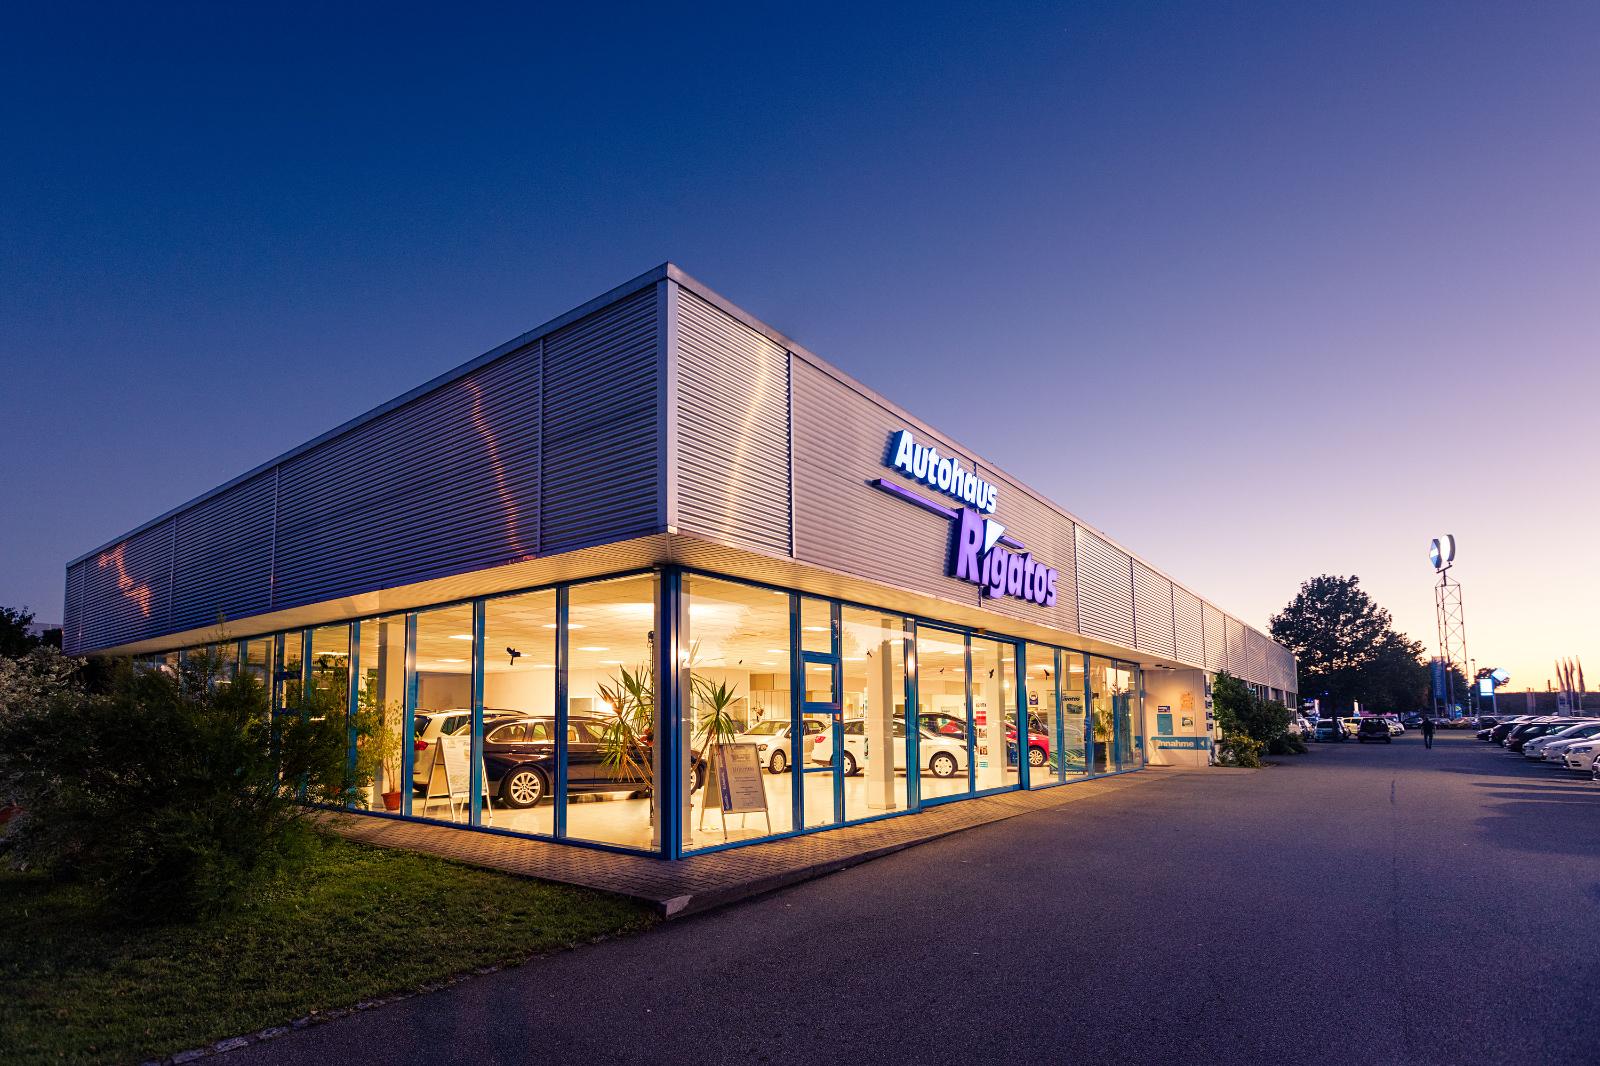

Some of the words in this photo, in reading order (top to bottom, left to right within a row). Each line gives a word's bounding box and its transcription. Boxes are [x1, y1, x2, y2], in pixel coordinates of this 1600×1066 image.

[894, 429, 998, 514] Autohaus
[955, 507, 1058, 607] Rigatos
[1156, 739, 1194, 748] nnahme
